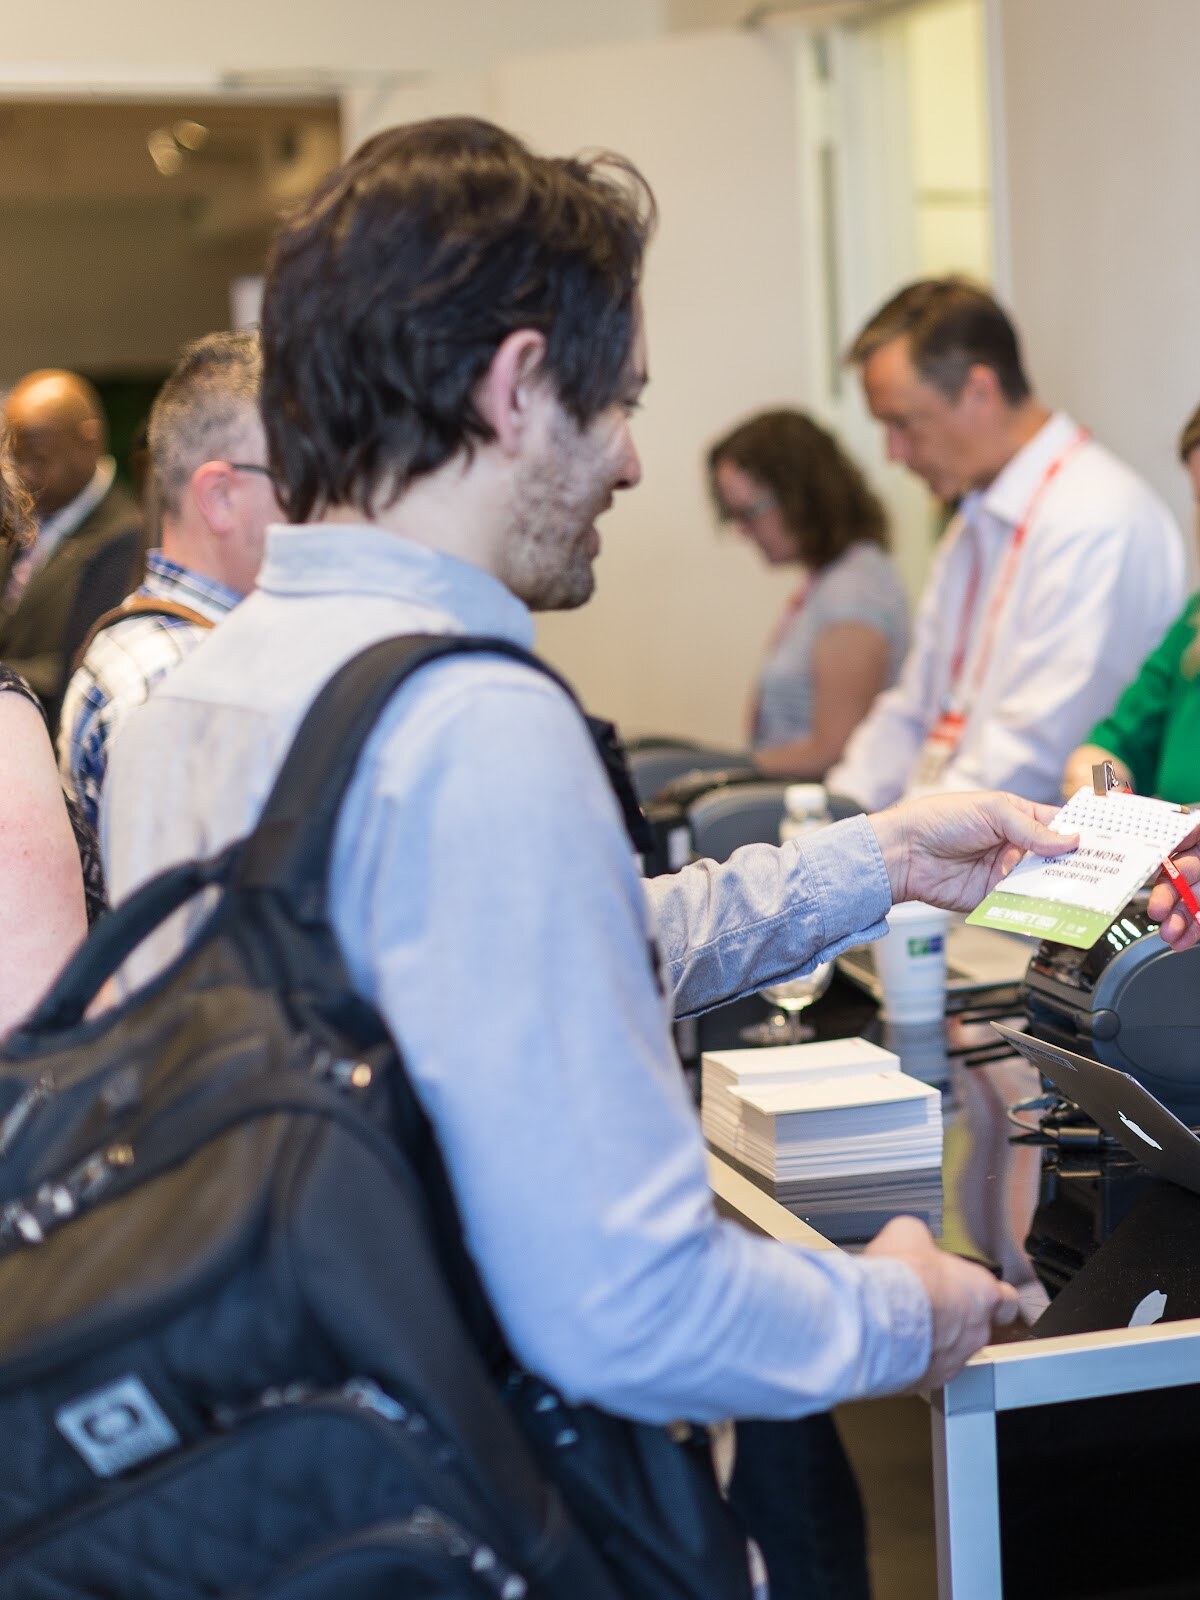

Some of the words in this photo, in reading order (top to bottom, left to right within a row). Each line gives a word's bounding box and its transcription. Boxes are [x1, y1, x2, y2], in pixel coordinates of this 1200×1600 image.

[1093, 849, 1126, 864] MOYAL
[1042, 856, 1070, 867] SENIOR
[1071, 860, 1100, 872] DESIGN
[1099, 865, 1120, 876] LEAD
